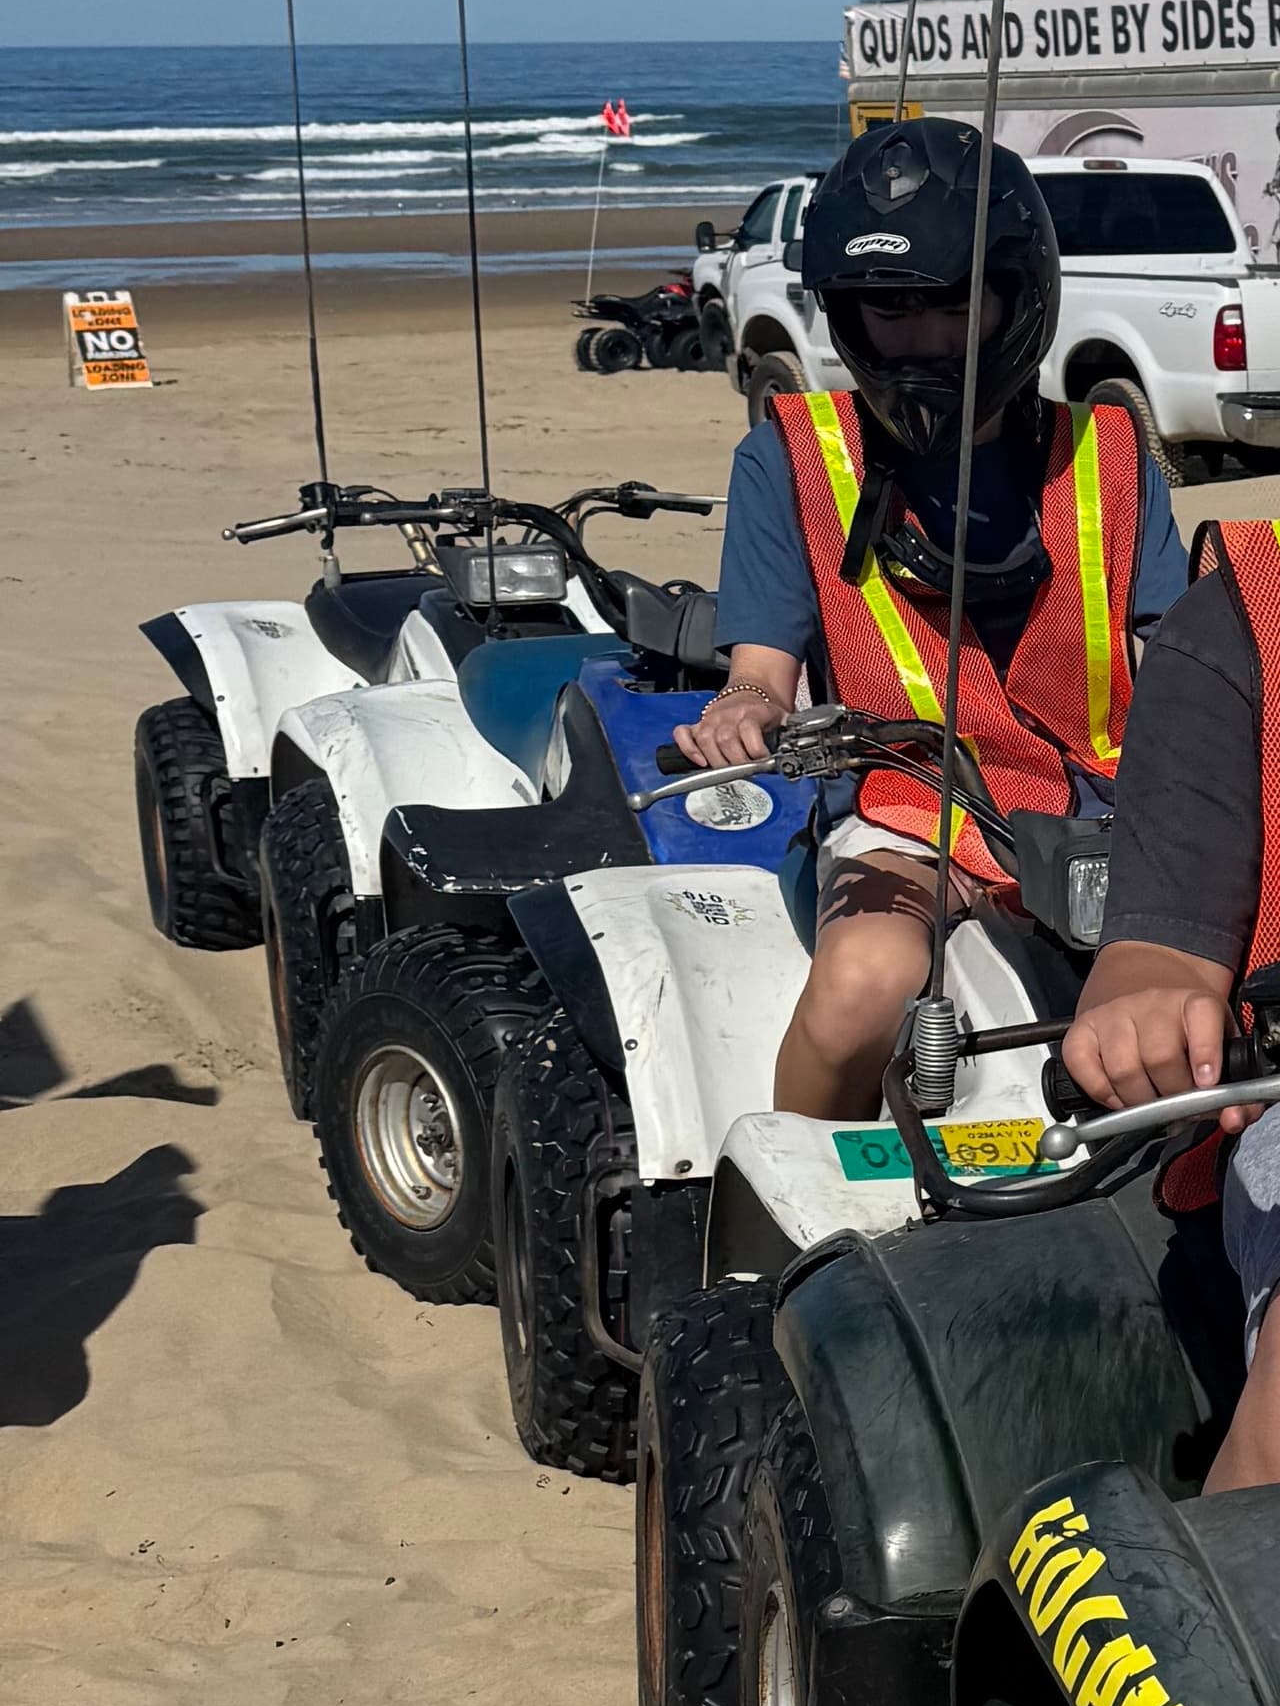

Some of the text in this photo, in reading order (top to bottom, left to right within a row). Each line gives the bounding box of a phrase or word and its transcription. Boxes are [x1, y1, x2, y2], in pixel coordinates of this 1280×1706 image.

[1035, 6, 1100, 58] SIDE
[1111, 2, 1152, 55] BY
[82, 329, 135, 351] NO
